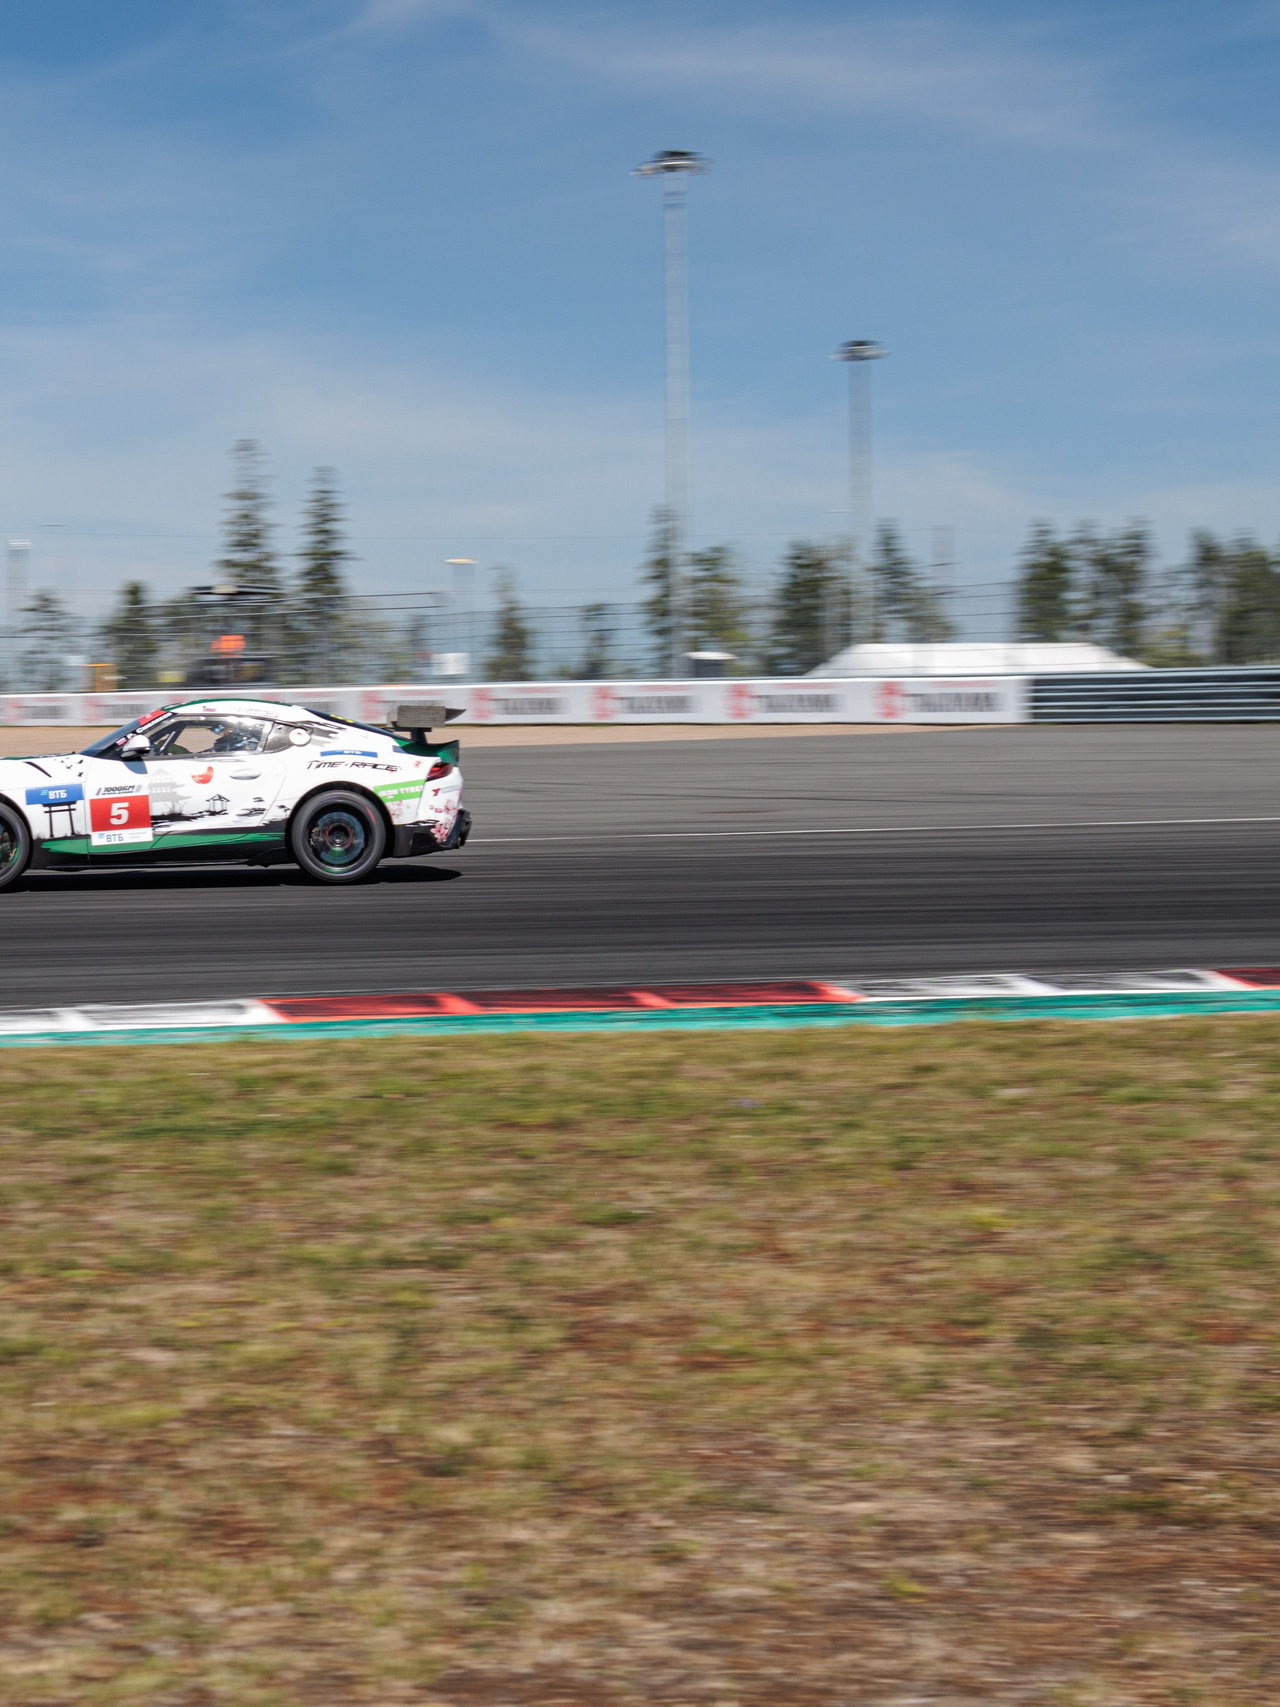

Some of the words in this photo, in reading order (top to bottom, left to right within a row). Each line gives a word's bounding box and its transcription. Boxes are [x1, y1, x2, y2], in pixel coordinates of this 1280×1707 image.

[48, 789, 68, 800] ВТБ
[109, 801, 130, 826] 5
[106, 833, 124, 843] ВТБ
